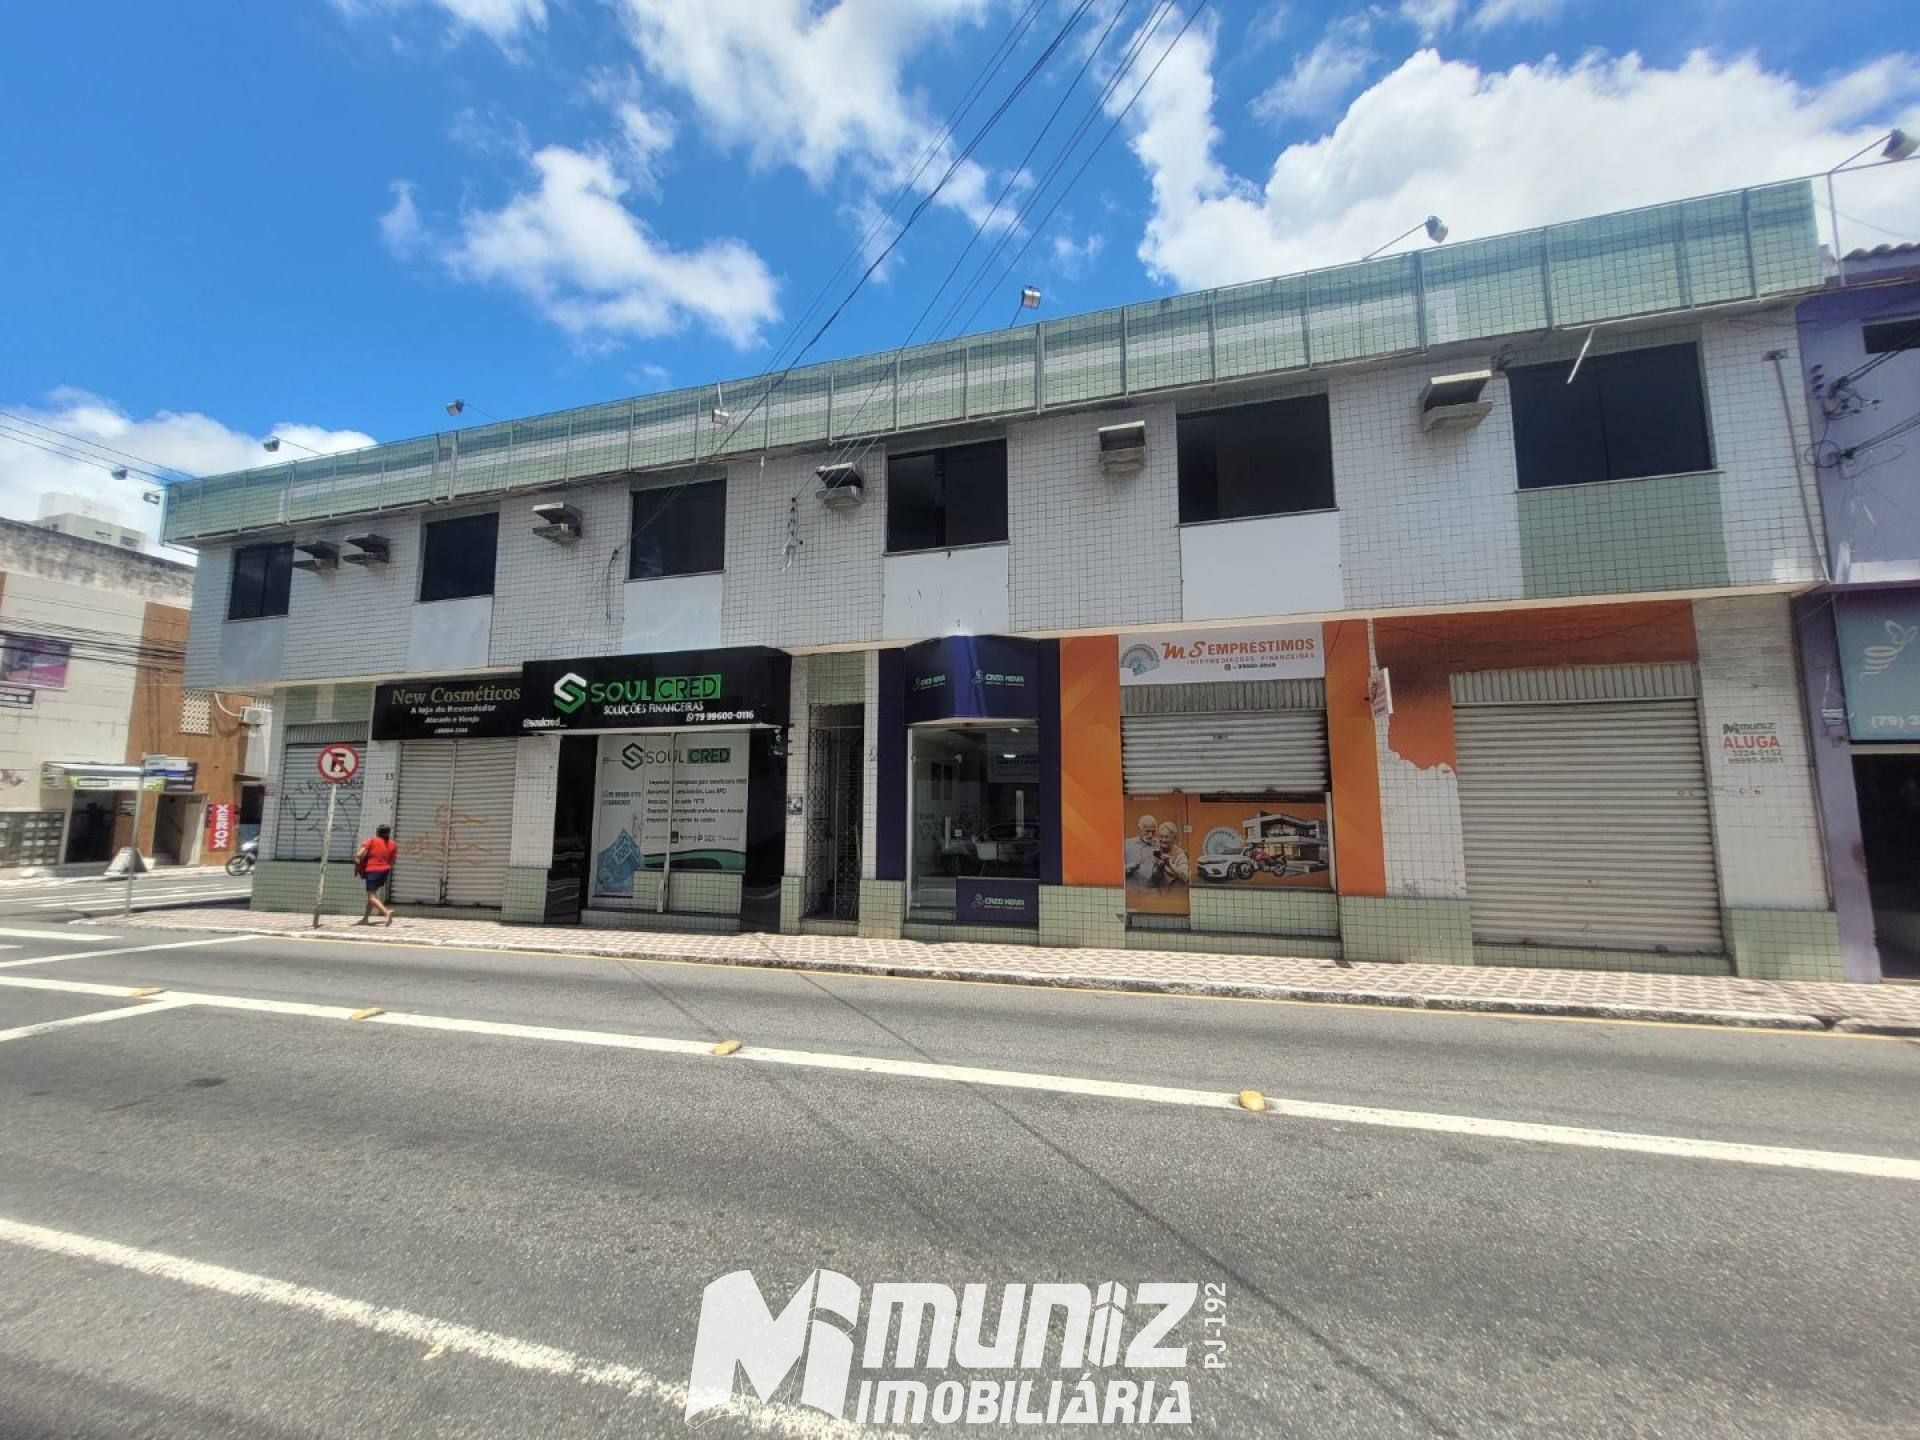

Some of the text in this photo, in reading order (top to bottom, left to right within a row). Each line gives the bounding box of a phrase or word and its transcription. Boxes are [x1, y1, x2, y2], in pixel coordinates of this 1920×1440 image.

[1207, 638, 1315, 655] EMPRÉSTIMOS
[392, 685, 521, 705] New Cosméticos
[591, 677, 718, 702] SOUL CRED
[603, 701, 704, 715] SOLUÇÕES FINANCEIRAS
[1871, 715, 1904, 729] (79)
[1723, 735, 1781, 749] ALUGA
[646, 749, 730, 764] SOUL CRED
[214, 804, 230, 849] XEROX
